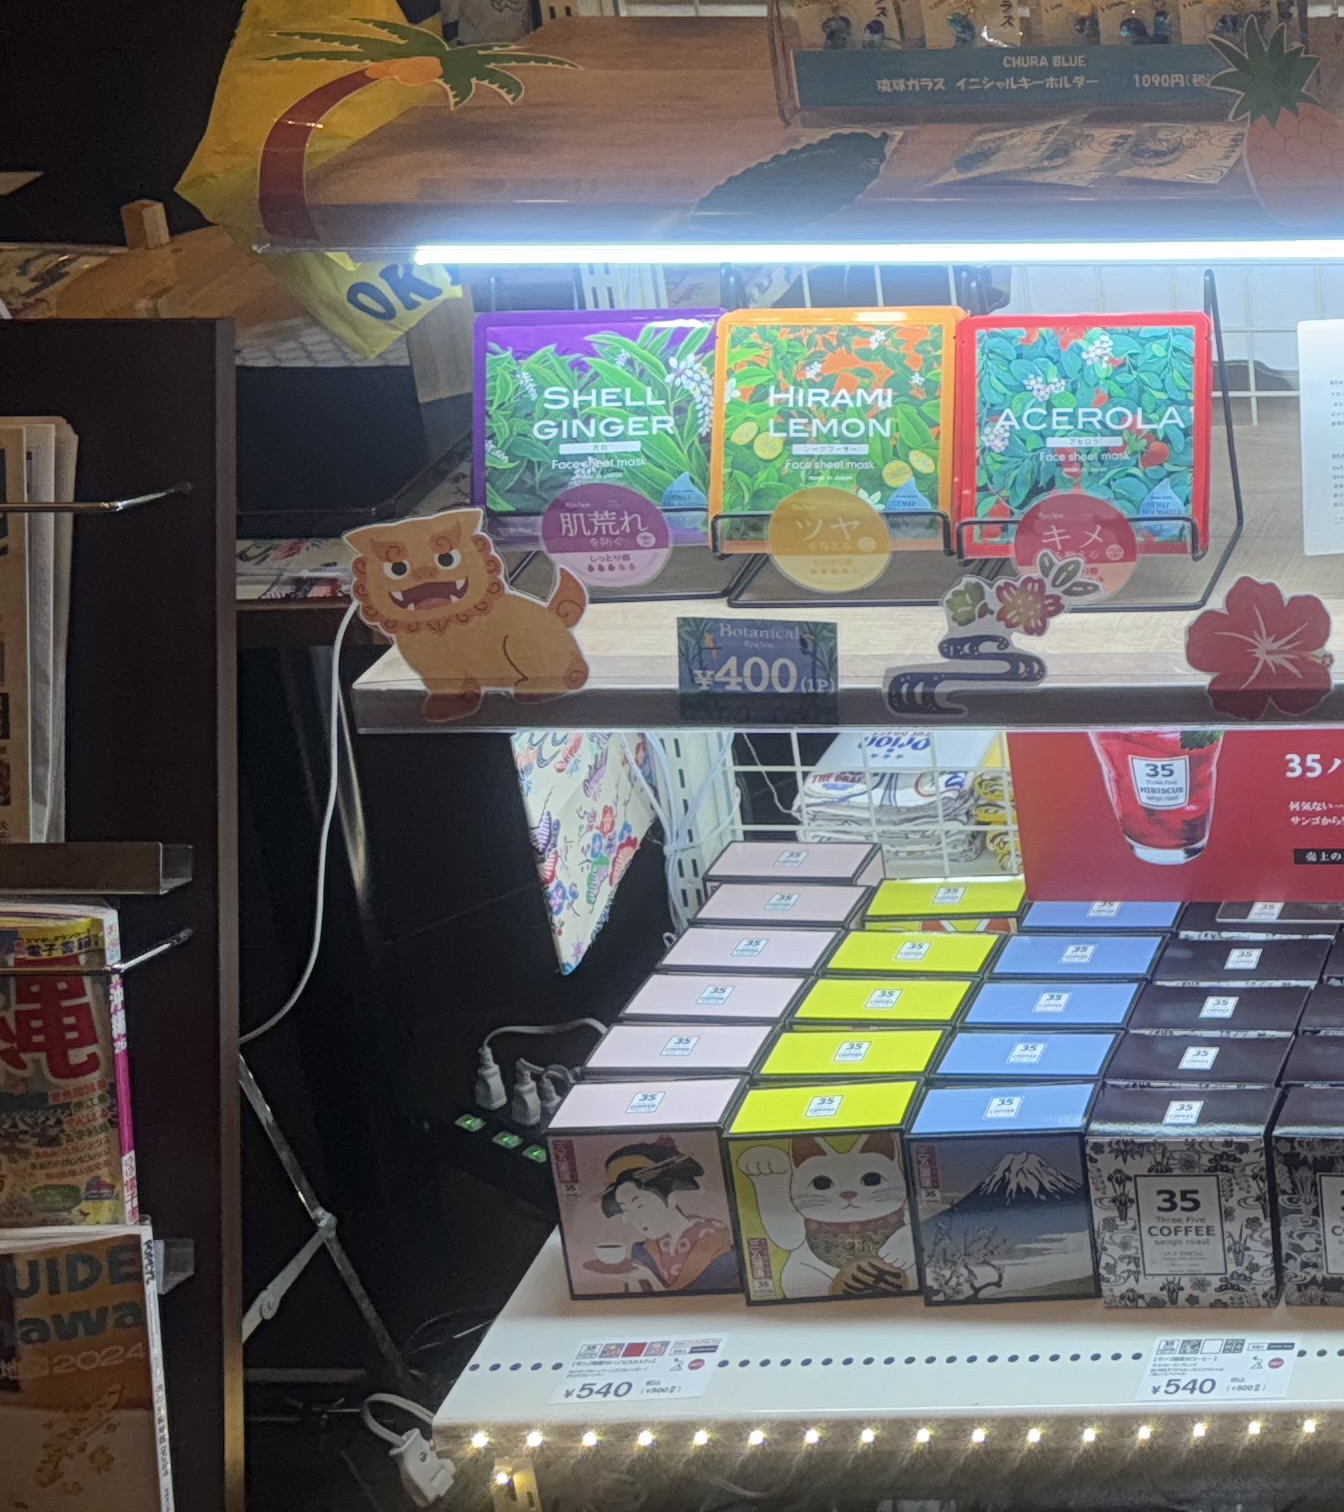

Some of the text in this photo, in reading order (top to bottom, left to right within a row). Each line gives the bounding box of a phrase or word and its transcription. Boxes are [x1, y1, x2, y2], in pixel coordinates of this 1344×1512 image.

[1003, 54, 1087, 68] CHURA BLUE
[956, 75, 1100, 90] イニシャルキーホルダー
[543, 386, 666, 410] SHELL
[768, 387, 893, 408] HIRAMI
[768, 417, 892, 438] LEMON
[995, 407, 1186, 431] ACEROLA
[532, 415, 675, 441] GINGER
[551, 456, 649, 470] Face sheet mask
[785, 459, 876, 470] Face sheet mask
[1039, 450, 1131, 462] Face sheet mask
[559, 511, 648, 536] 肌荒れ
[795, 516, 862, 541] ツヤ
[1041, 523, 1104, 550] キメ
[719, 622, 800, 641] Botanical
[693, 655, 836, 694] ¥400 (1P)
[1144, 763, 1175, 778] 35
[1139, 786, 1184, 794] HIBISCUS
[1212, 998, 1229, 1006] 35
[639, 1093, 657, 1101] 35
[997, 1098, 1014, 1106] 35
[1176, 1103, 1193, 1112] 35
[1156, 1189, 1201, 1212] 35
[1147, 1225, 1216, 1238] COFFEE
[564, 1381, 633, 1399] ¥540
[1151, 1378, 1217, 1395] ¥540
